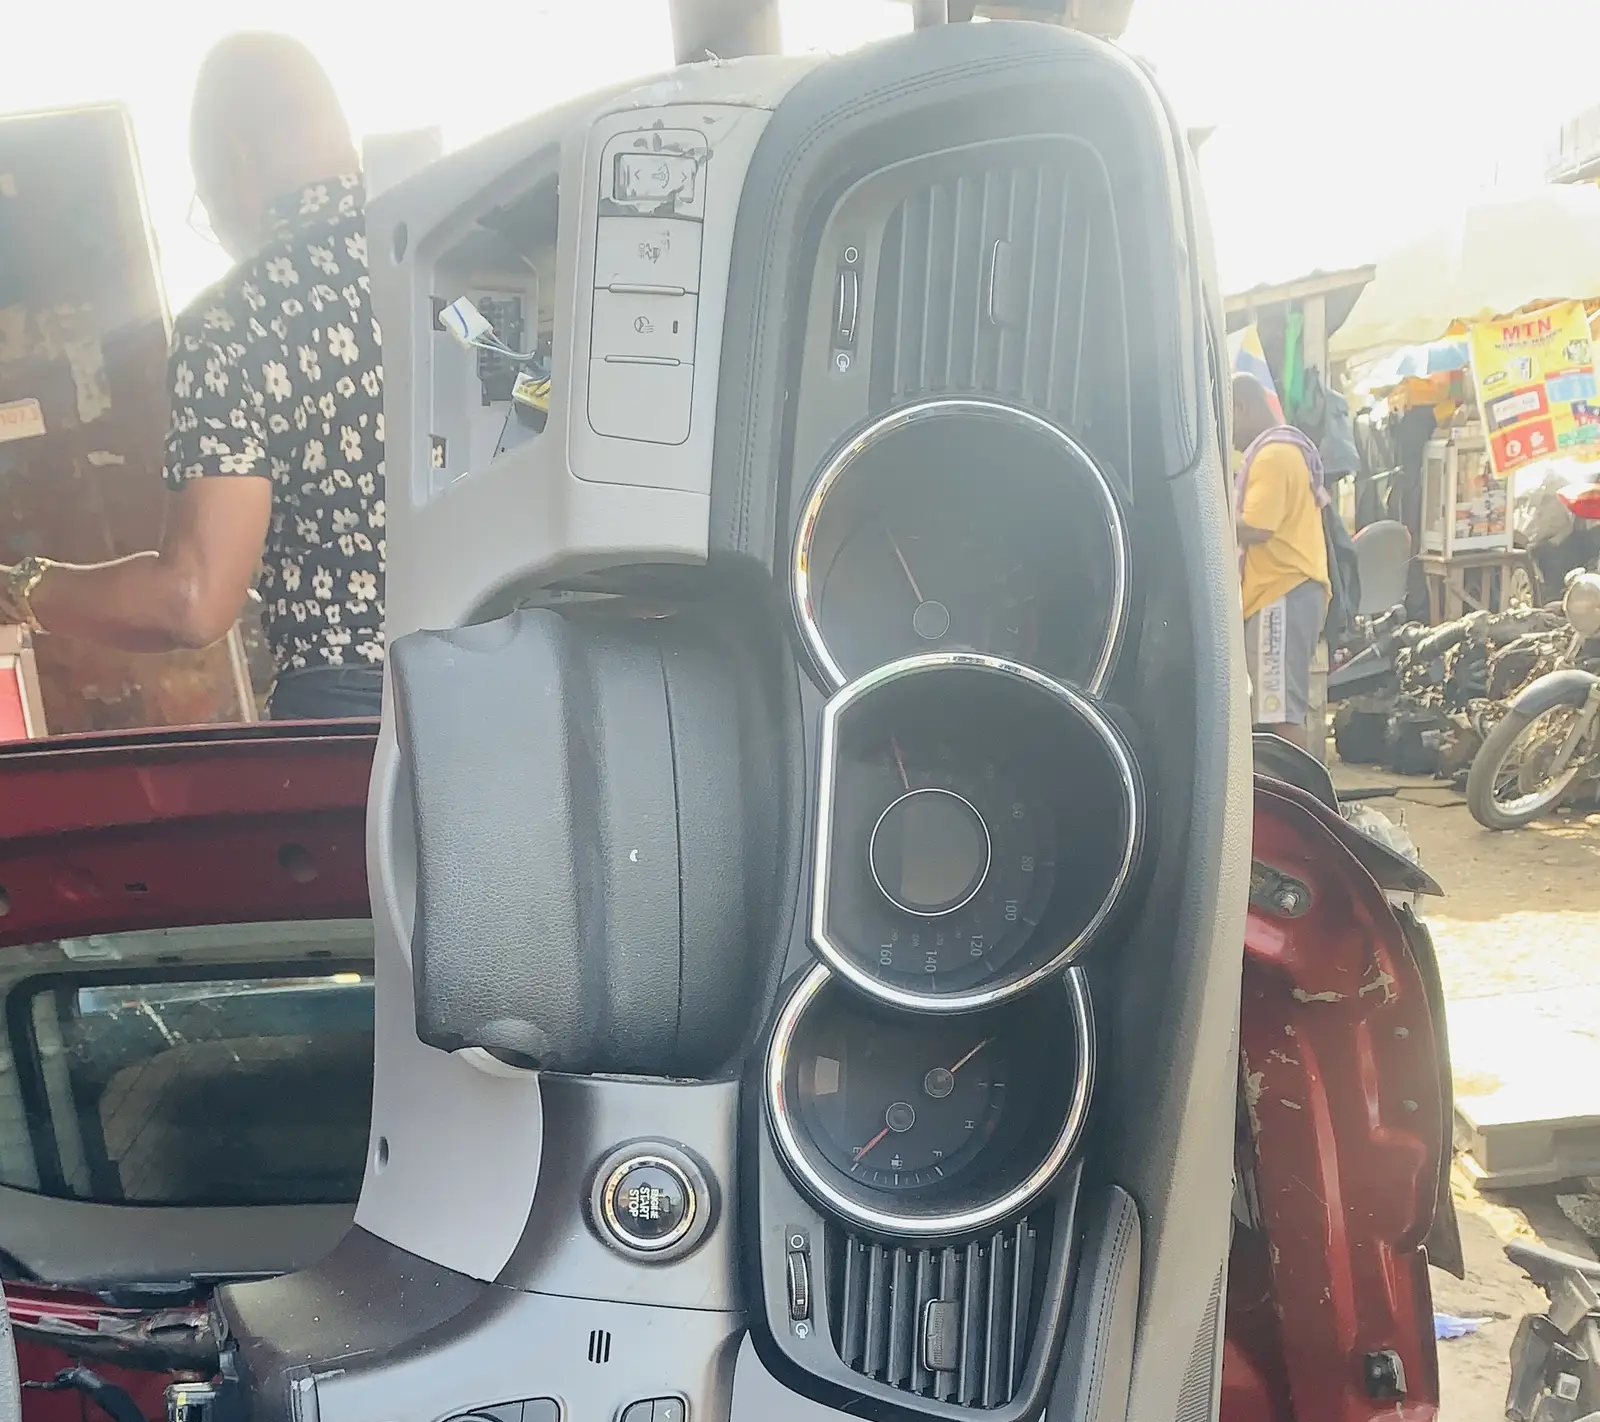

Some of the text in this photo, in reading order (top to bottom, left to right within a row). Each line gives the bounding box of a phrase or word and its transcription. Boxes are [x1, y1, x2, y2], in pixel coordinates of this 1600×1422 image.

[1502, 316, 1552, 340] MTN
[1021, 856, 1034, 872] 80
[1005, 899, 1018, 921] 100
[879, 943, 893, 966] 160
[970, 934, 983, 957] 120
[925, 950, 937, 973] 140
[628, 1189, 640, 1218] STOP
[640, 1186, 651, 1220] START
